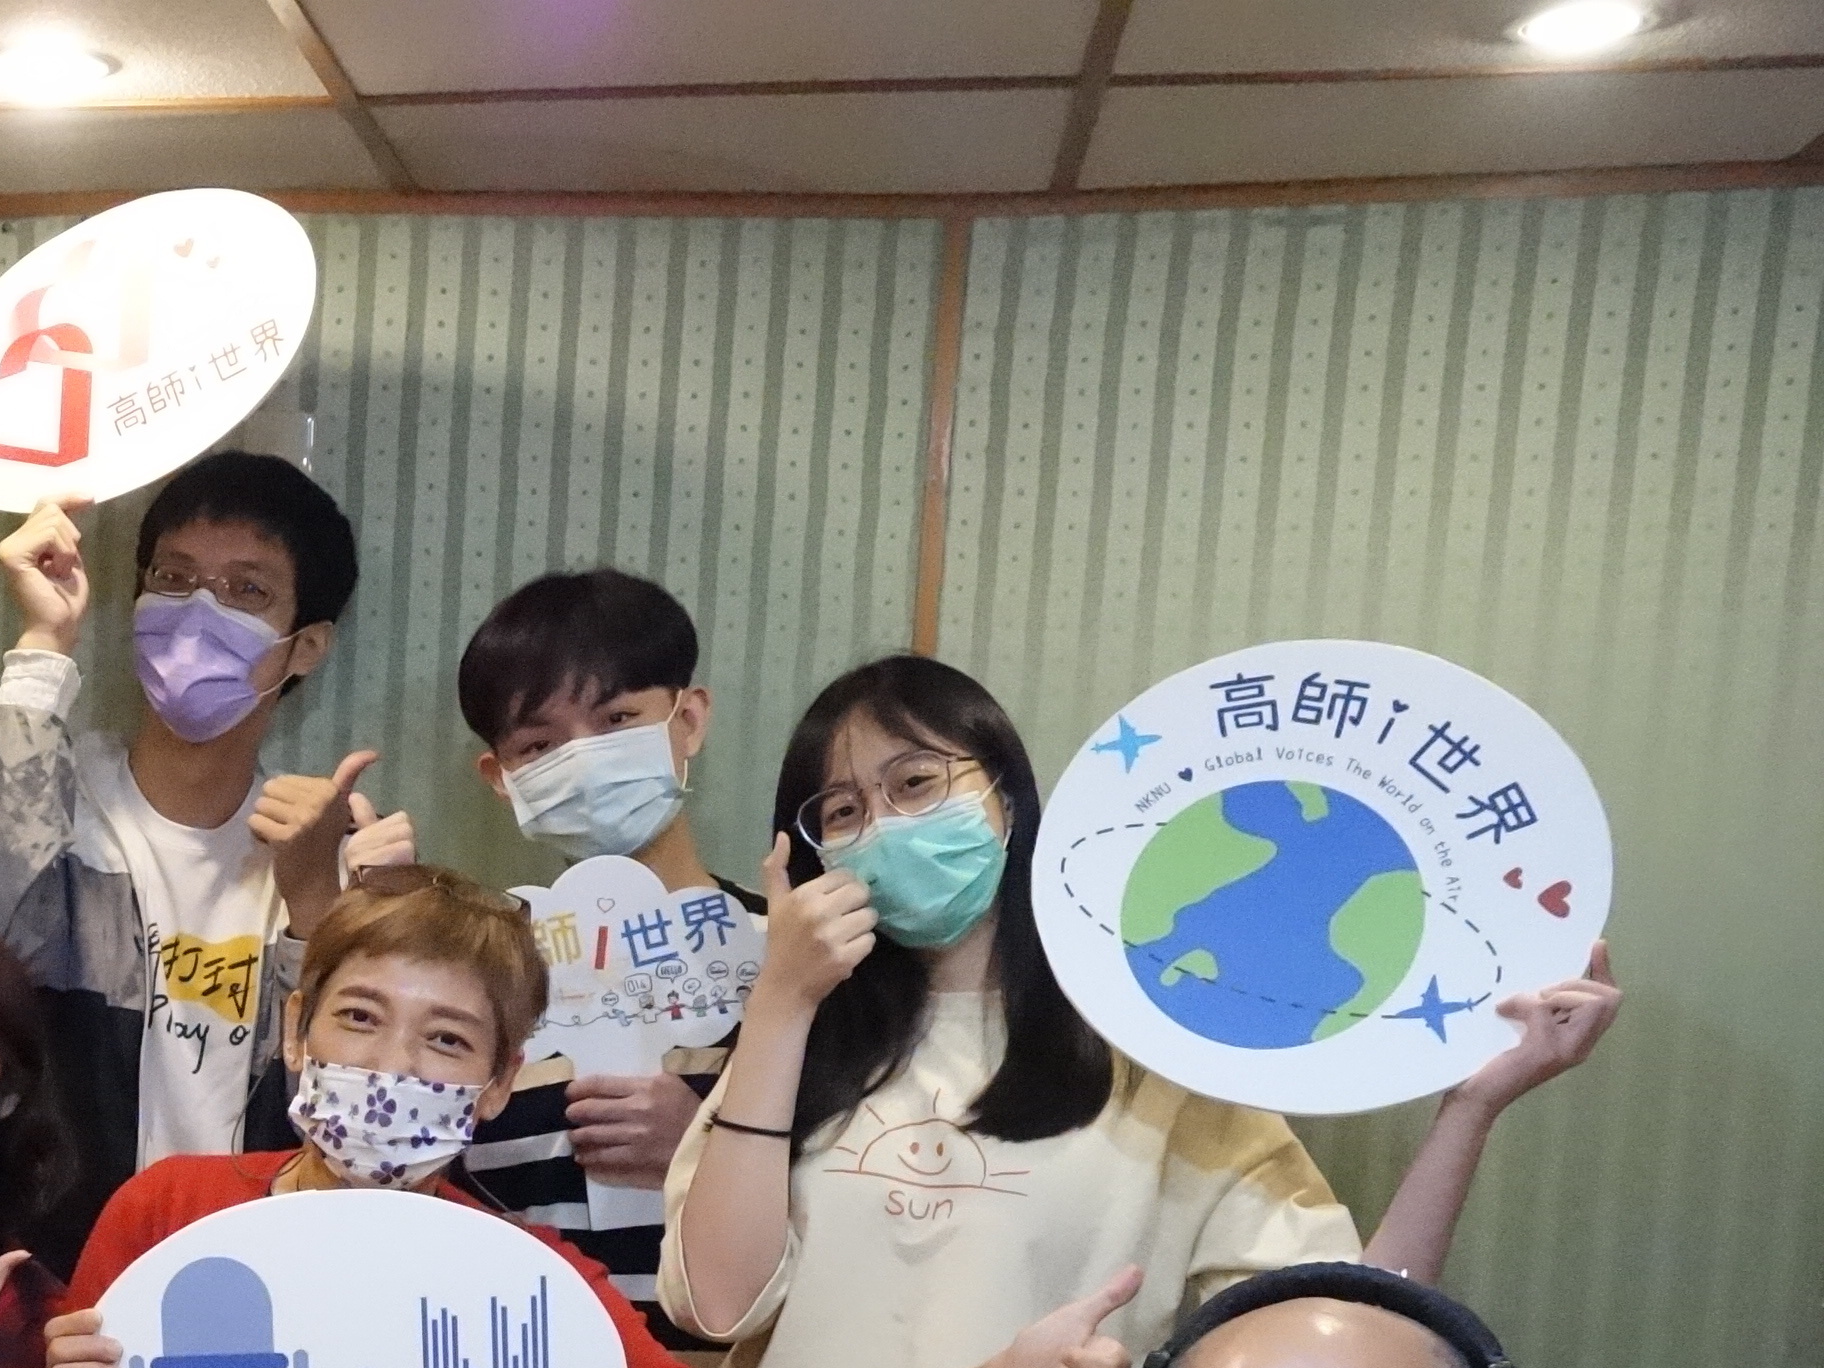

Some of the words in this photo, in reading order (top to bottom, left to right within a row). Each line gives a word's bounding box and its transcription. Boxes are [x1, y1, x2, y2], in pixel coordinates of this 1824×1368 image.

[1134, 782, 1172, 813] NKNU
[1204, 747, 1263, 772] Global
[1276, 747, 1334, 766] Voices
[1346, 758, 1372, 780] The
[1378, 774, 1423, 813] World
[1419, 818, 1435, 835] on
[1434, 841, 1453, 867] the
[1446, 876, 1462, 903] Air
